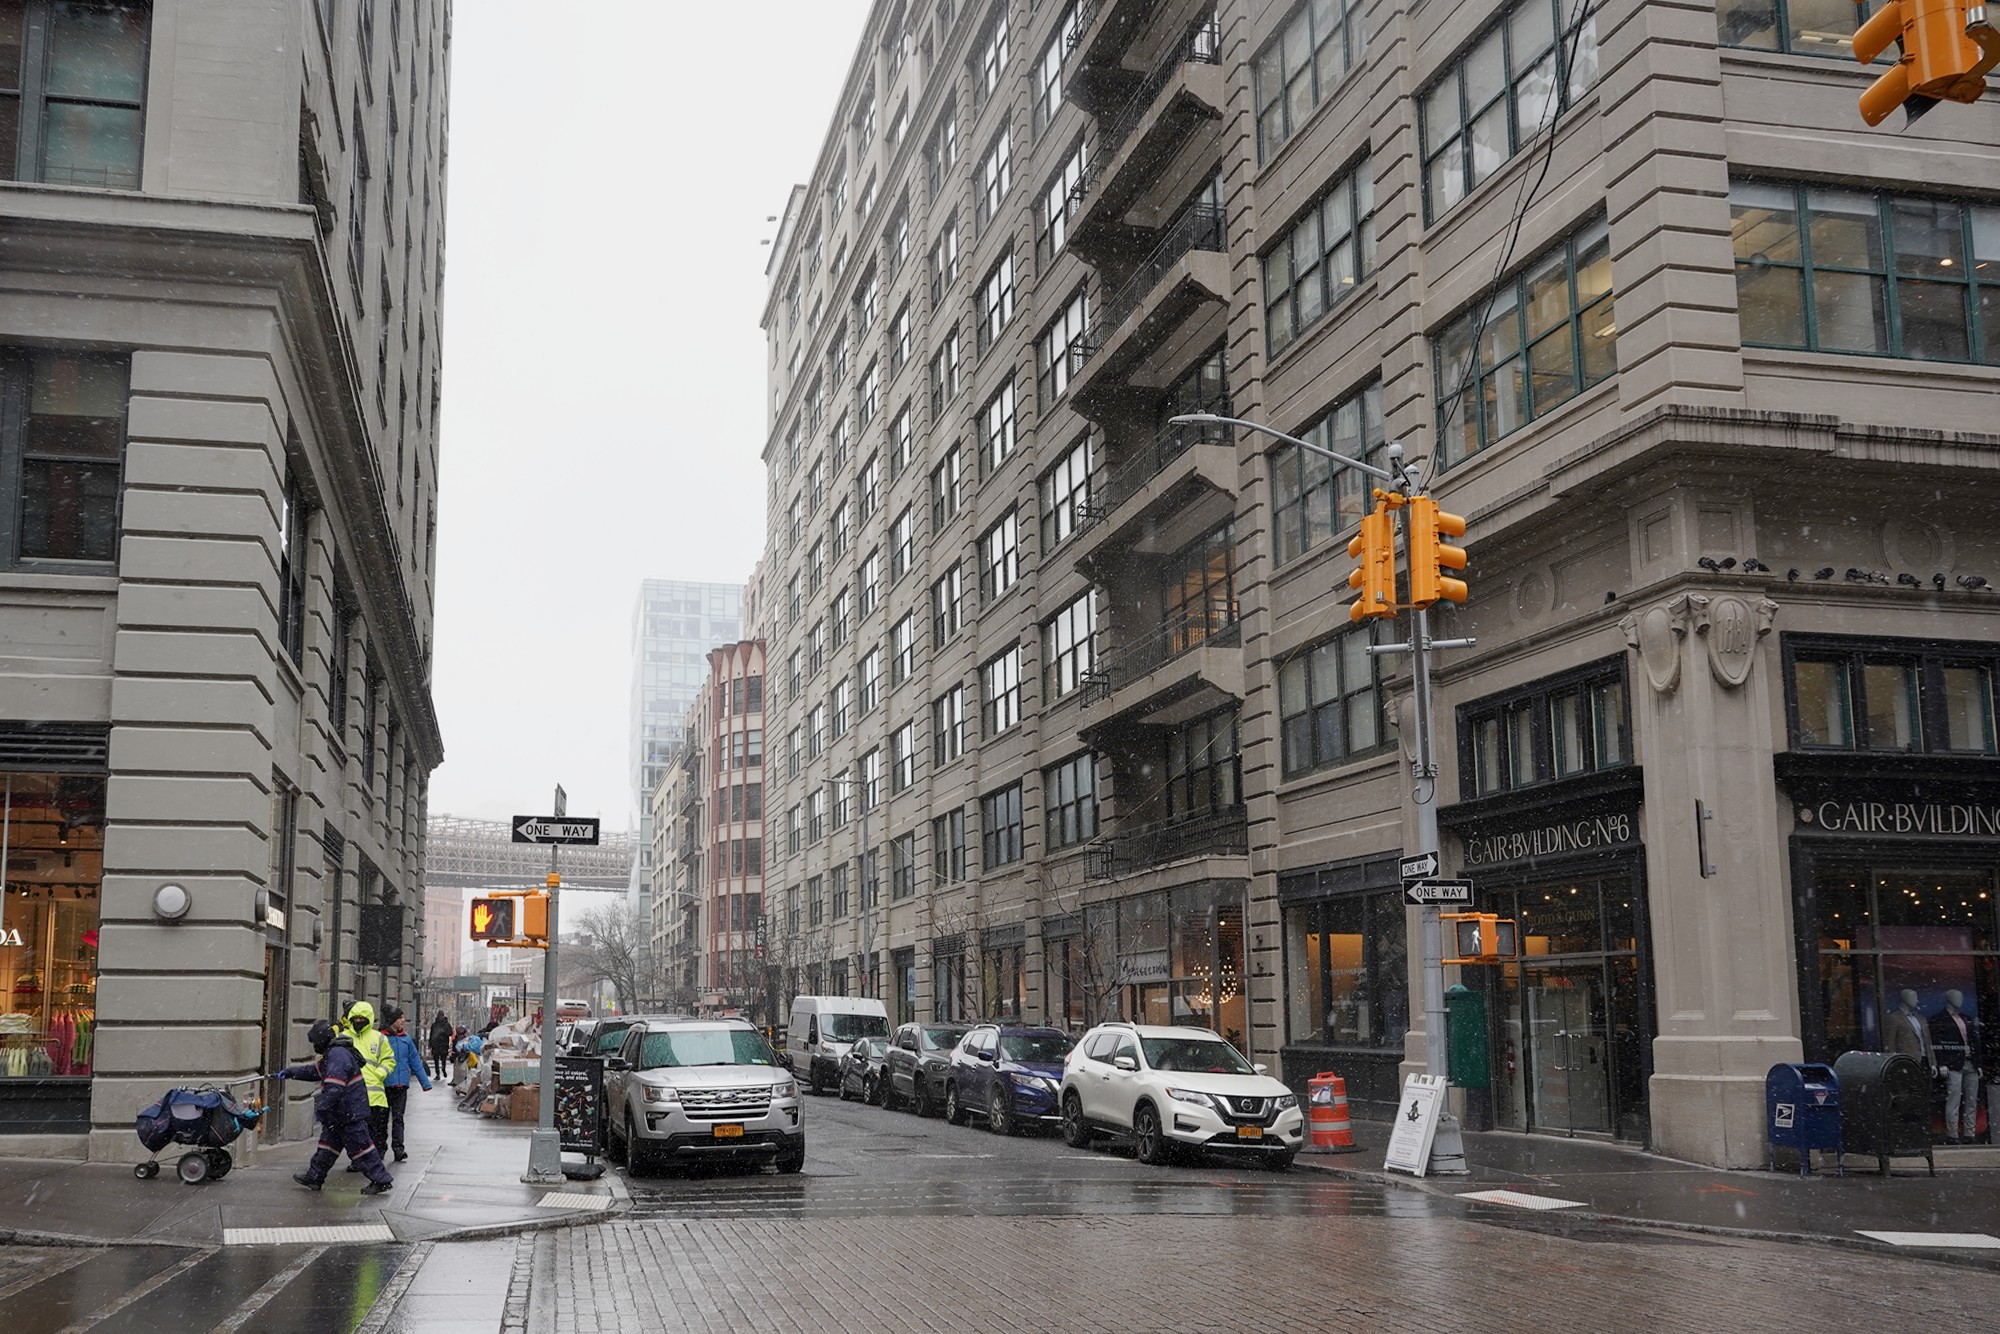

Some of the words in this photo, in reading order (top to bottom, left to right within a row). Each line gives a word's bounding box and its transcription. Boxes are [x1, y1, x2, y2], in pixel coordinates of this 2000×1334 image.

[525, 824, 550, 836] ONE
[562, 825, 589, 837] WAY
[1404, 863, 1416, 875] ONE
[1416, 861, 1429, 872] WAY
[1416, 887, 1437, 898] ONE
[1442, 887, 1463, 898] WAY
